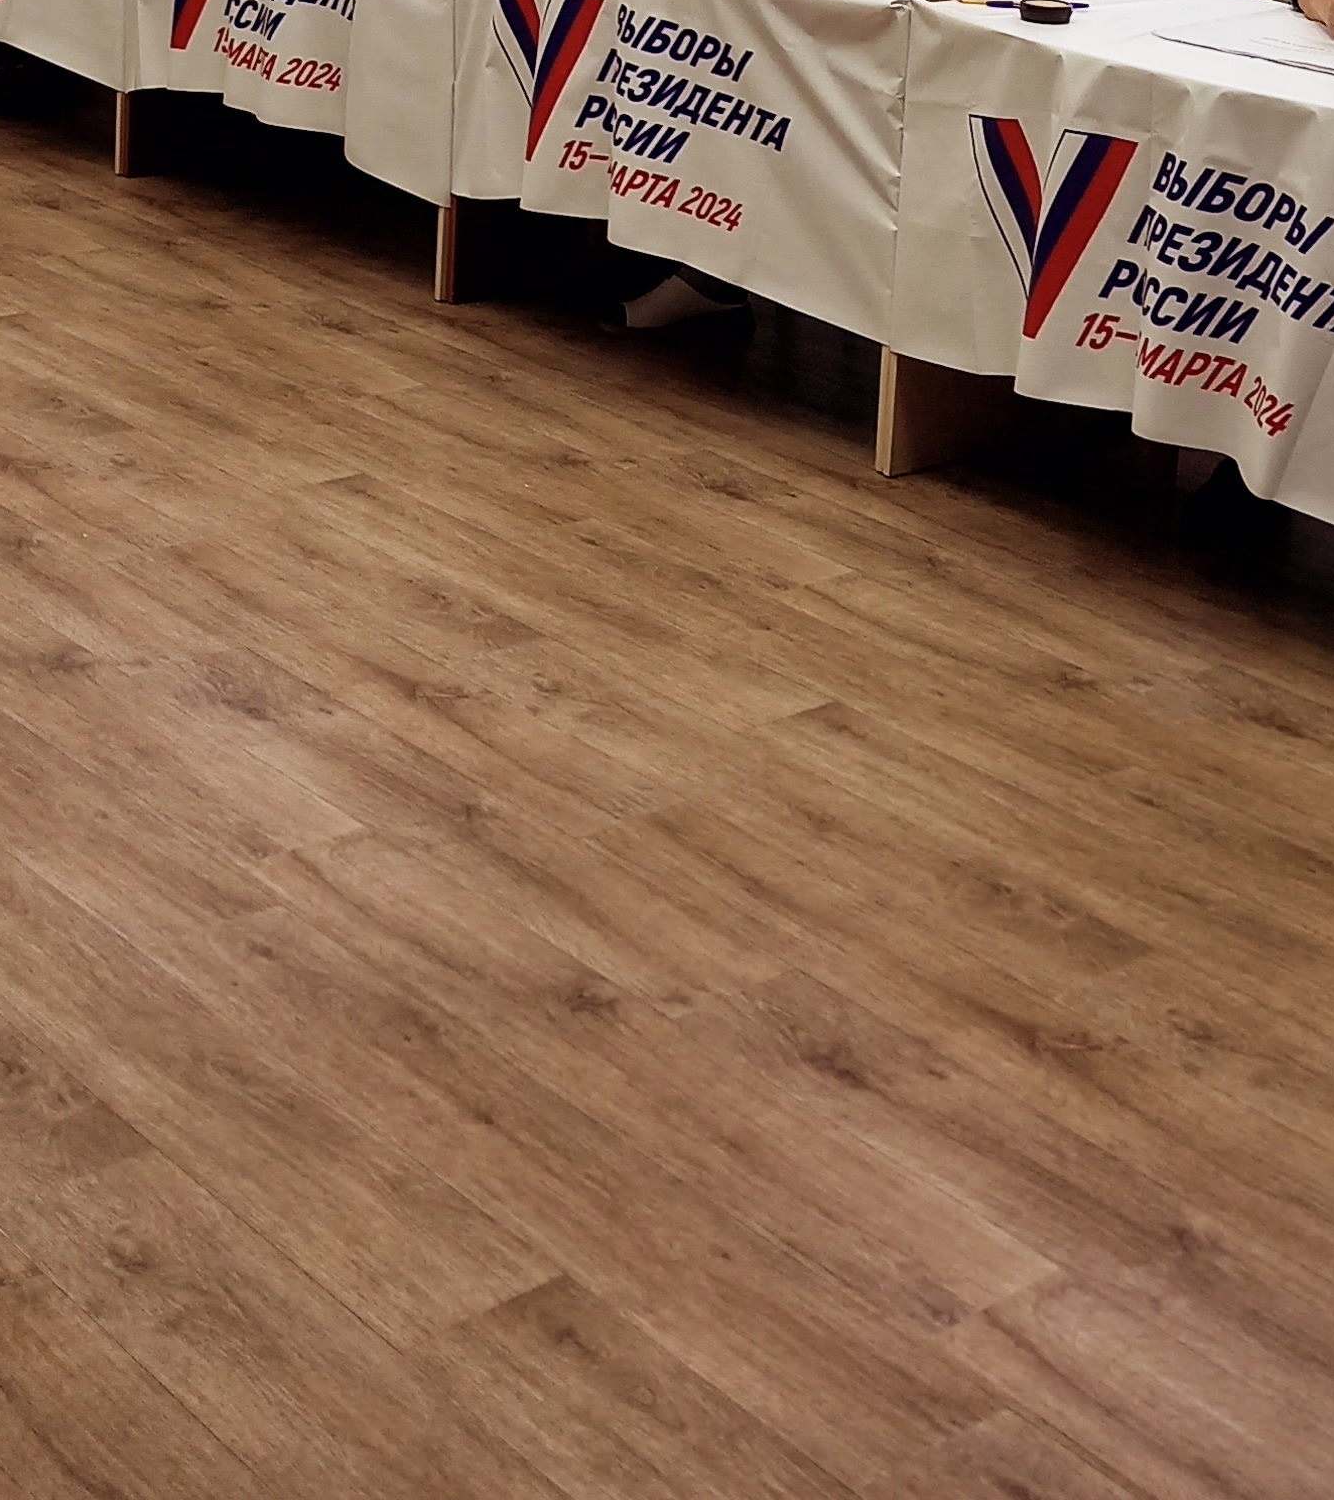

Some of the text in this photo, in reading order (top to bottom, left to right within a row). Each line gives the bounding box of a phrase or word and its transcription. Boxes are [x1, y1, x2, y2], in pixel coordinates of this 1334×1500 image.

[276, 58, 342, 92] 2024
[677, 185, 743, 232] 2024
[1243, 376, 1295, 437] 2024
